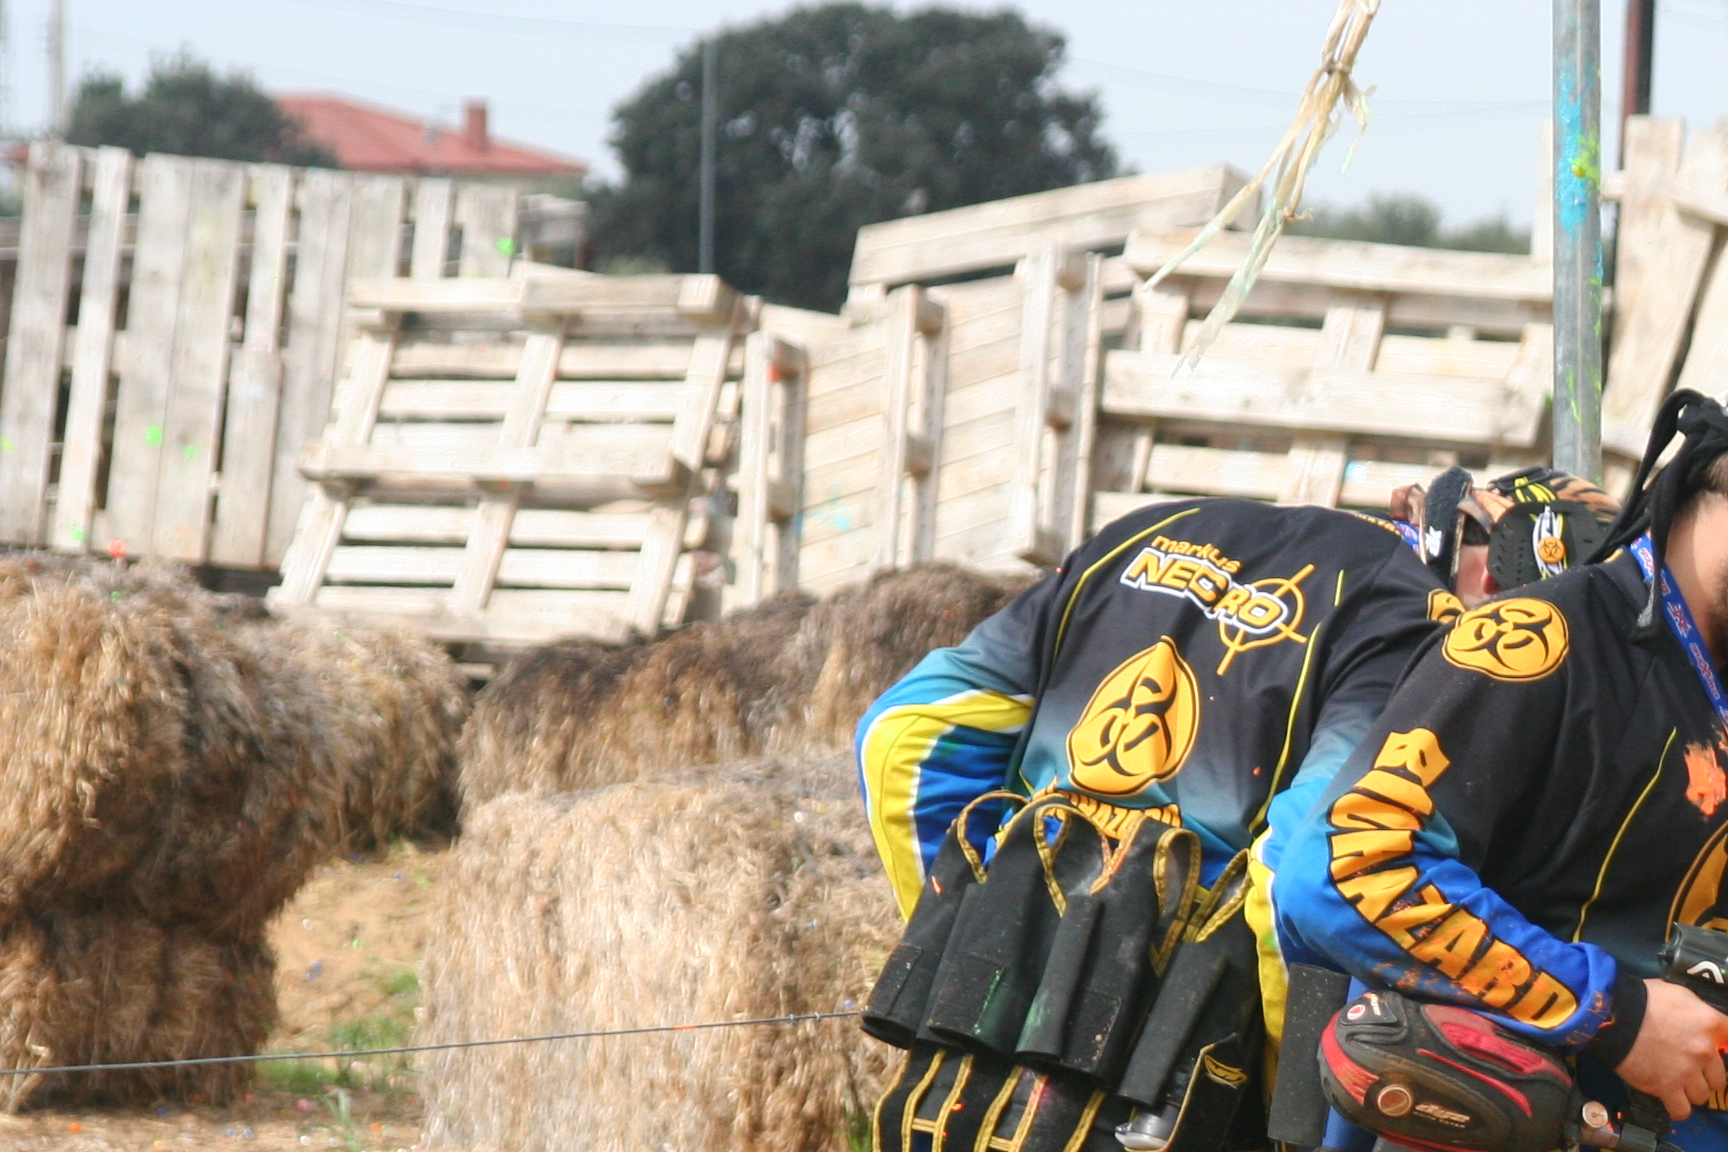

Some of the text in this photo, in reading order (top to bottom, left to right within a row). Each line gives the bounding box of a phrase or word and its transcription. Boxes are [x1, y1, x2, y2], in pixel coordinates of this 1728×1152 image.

[1121, 548, 1288, 634] NECRO
[1151, 535, 1241, 574] markus
[1327, 727, 1579, 1031] BIOHAZARD
